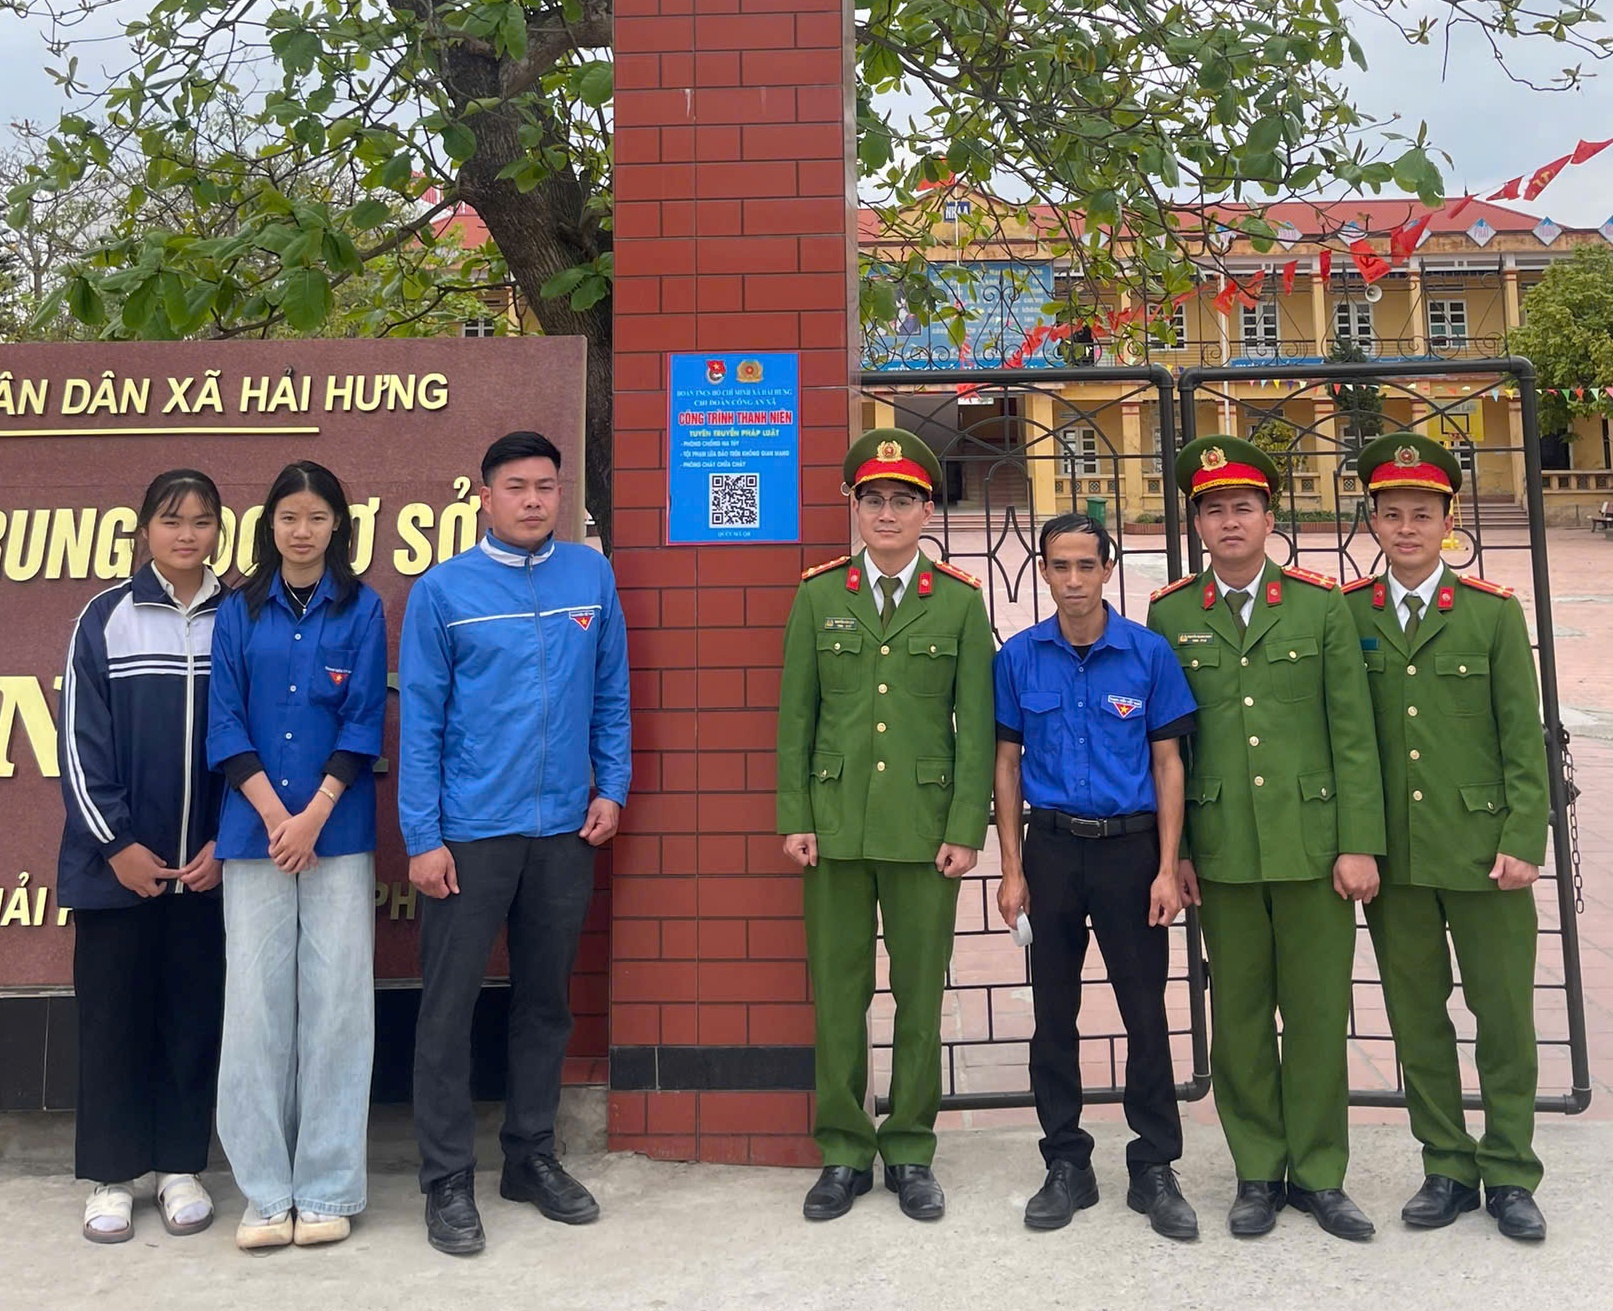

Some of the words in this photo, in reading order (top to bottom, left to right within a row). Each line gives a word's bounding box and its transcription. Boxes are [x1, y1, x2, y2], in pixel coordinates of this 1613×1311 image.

[61, 370, 150, 414] DÂN
[162, 369, 223, 413] XÃ
[239, 364, 312, 412] HẢI
[324, 372, 448, 411] HƯNG
[678, 408, 705, 426] CÔNG
[706, 408, 735, 425] TRÌNH
[736, 410, 768, 425] THANH
[769, 407, 793, 425] NIÊN
[0, 506, 138, 582] UNG
[393, 476, 481, 576] SỞ
[0, 872, 48, 927] ẢI
